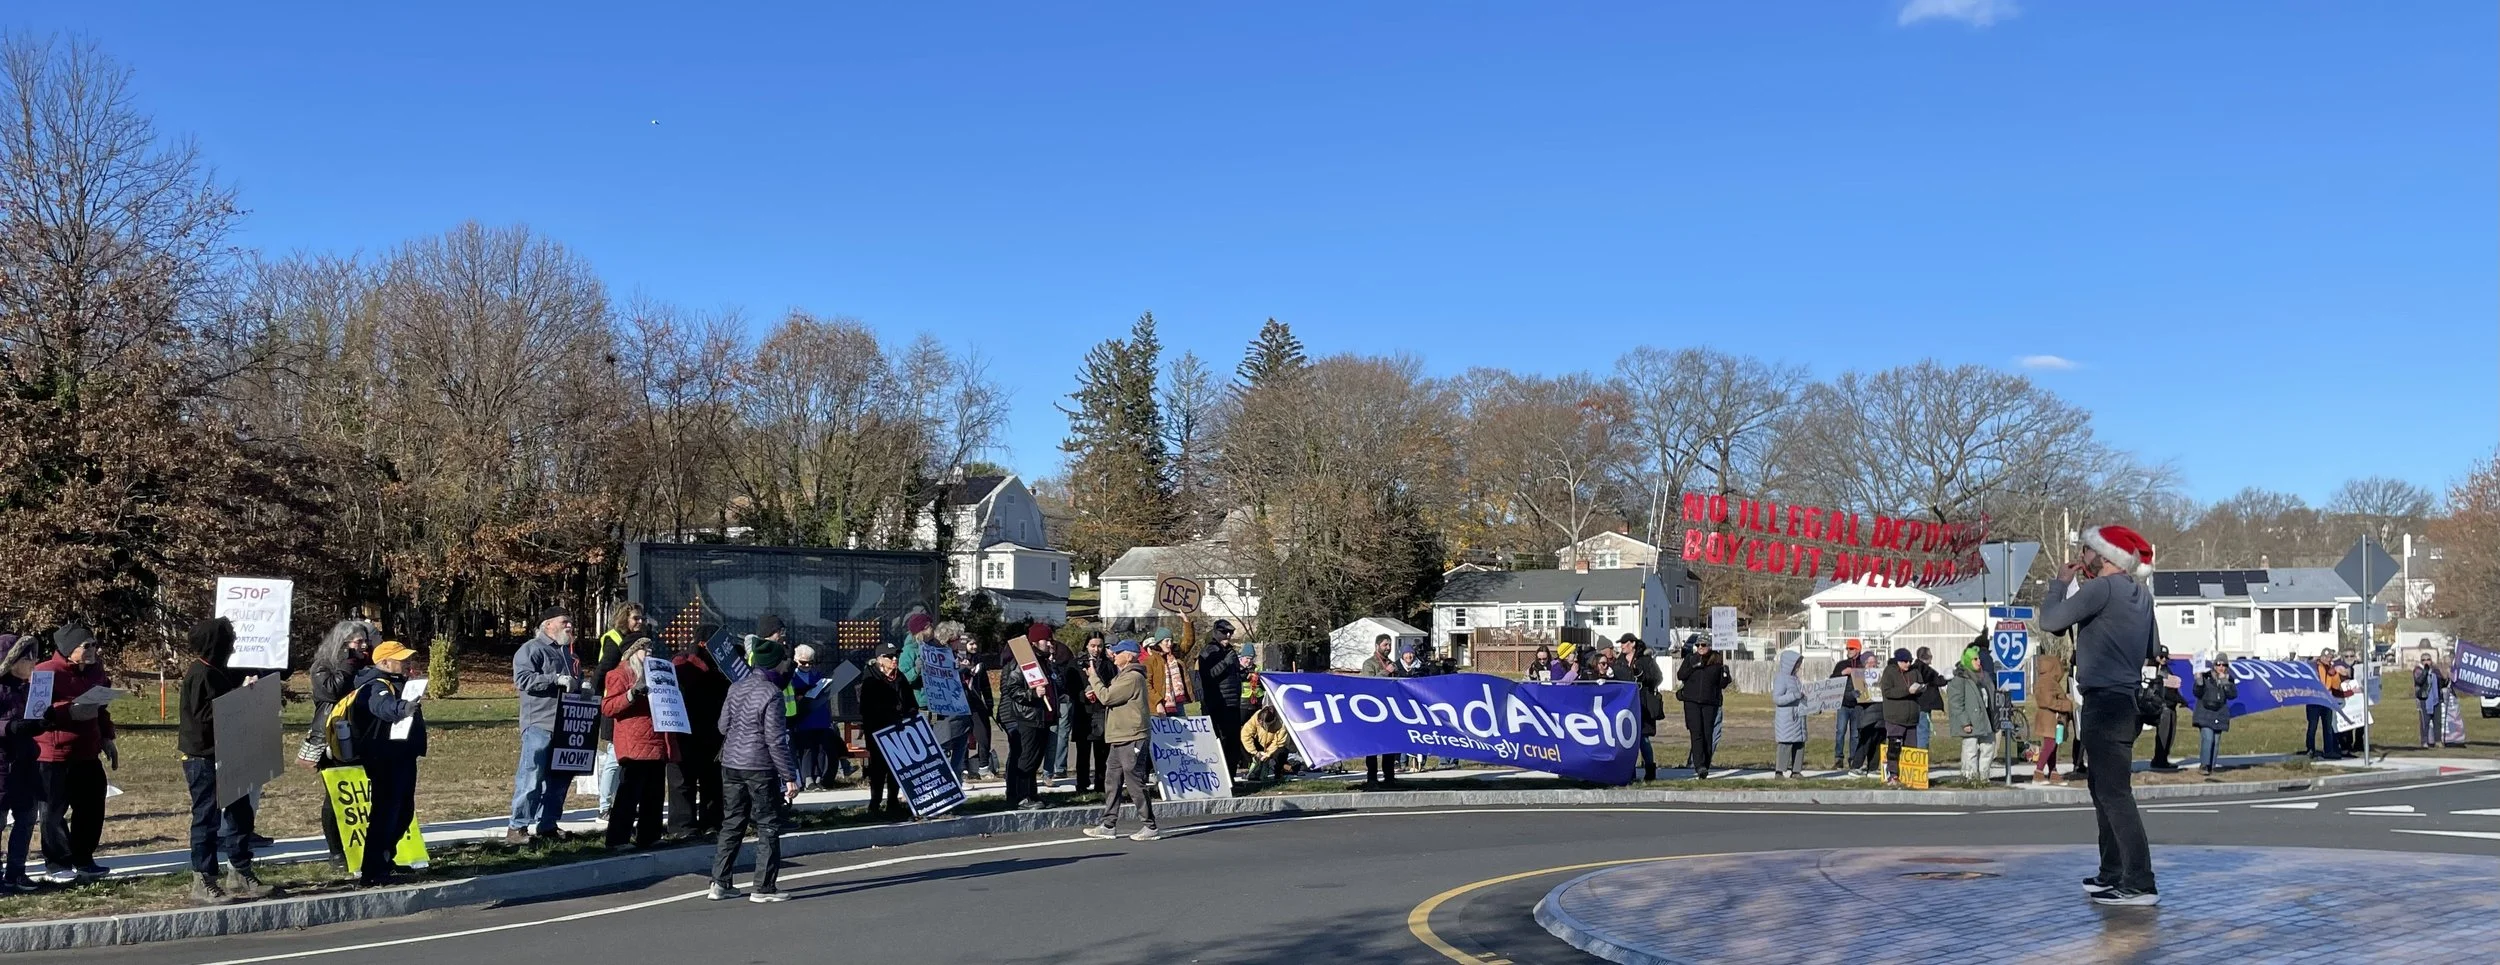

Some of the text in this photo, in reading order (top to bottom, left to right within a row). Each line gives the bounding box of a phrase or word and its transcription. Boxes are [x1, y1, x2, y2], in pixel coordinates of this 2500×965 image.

[1682, 491, 1728, 523] NO
[1738, 499, 1859, 547] ILLEGAL
[1682, 528, 1824, 579] BOYCOTT
[1830, 551, 1913, 589] AVELO
[227, 586, 271, 600] STOP
[1163, 585, 1196, 607] ICE
[2006, 608, 2016, 618] TO
[240, 624, 255, 632] NO
[1997, 633, 2025, 660] 95
[922, 649, 946, 666] STOP
[2462, 651, 2498, 673] STAND
[562, 705, 598, 719] TRUMP
[1278, 683, 1638, 749] GroundAvelo
[563, 719, 593, 733] MUST
[568, 734, 585, 747] GO
[880, 720, 938, 771] NO!
[1407, 728, 1561, 762] Refreshingly cruel
[558, 750, 590, 766] NOW!
[911, 768, 941, 787] WE REFUSE
[913, 776, 947, 795] TO ACCEPT A
[913, 780, 957, 806] FASCIST AMERICA
